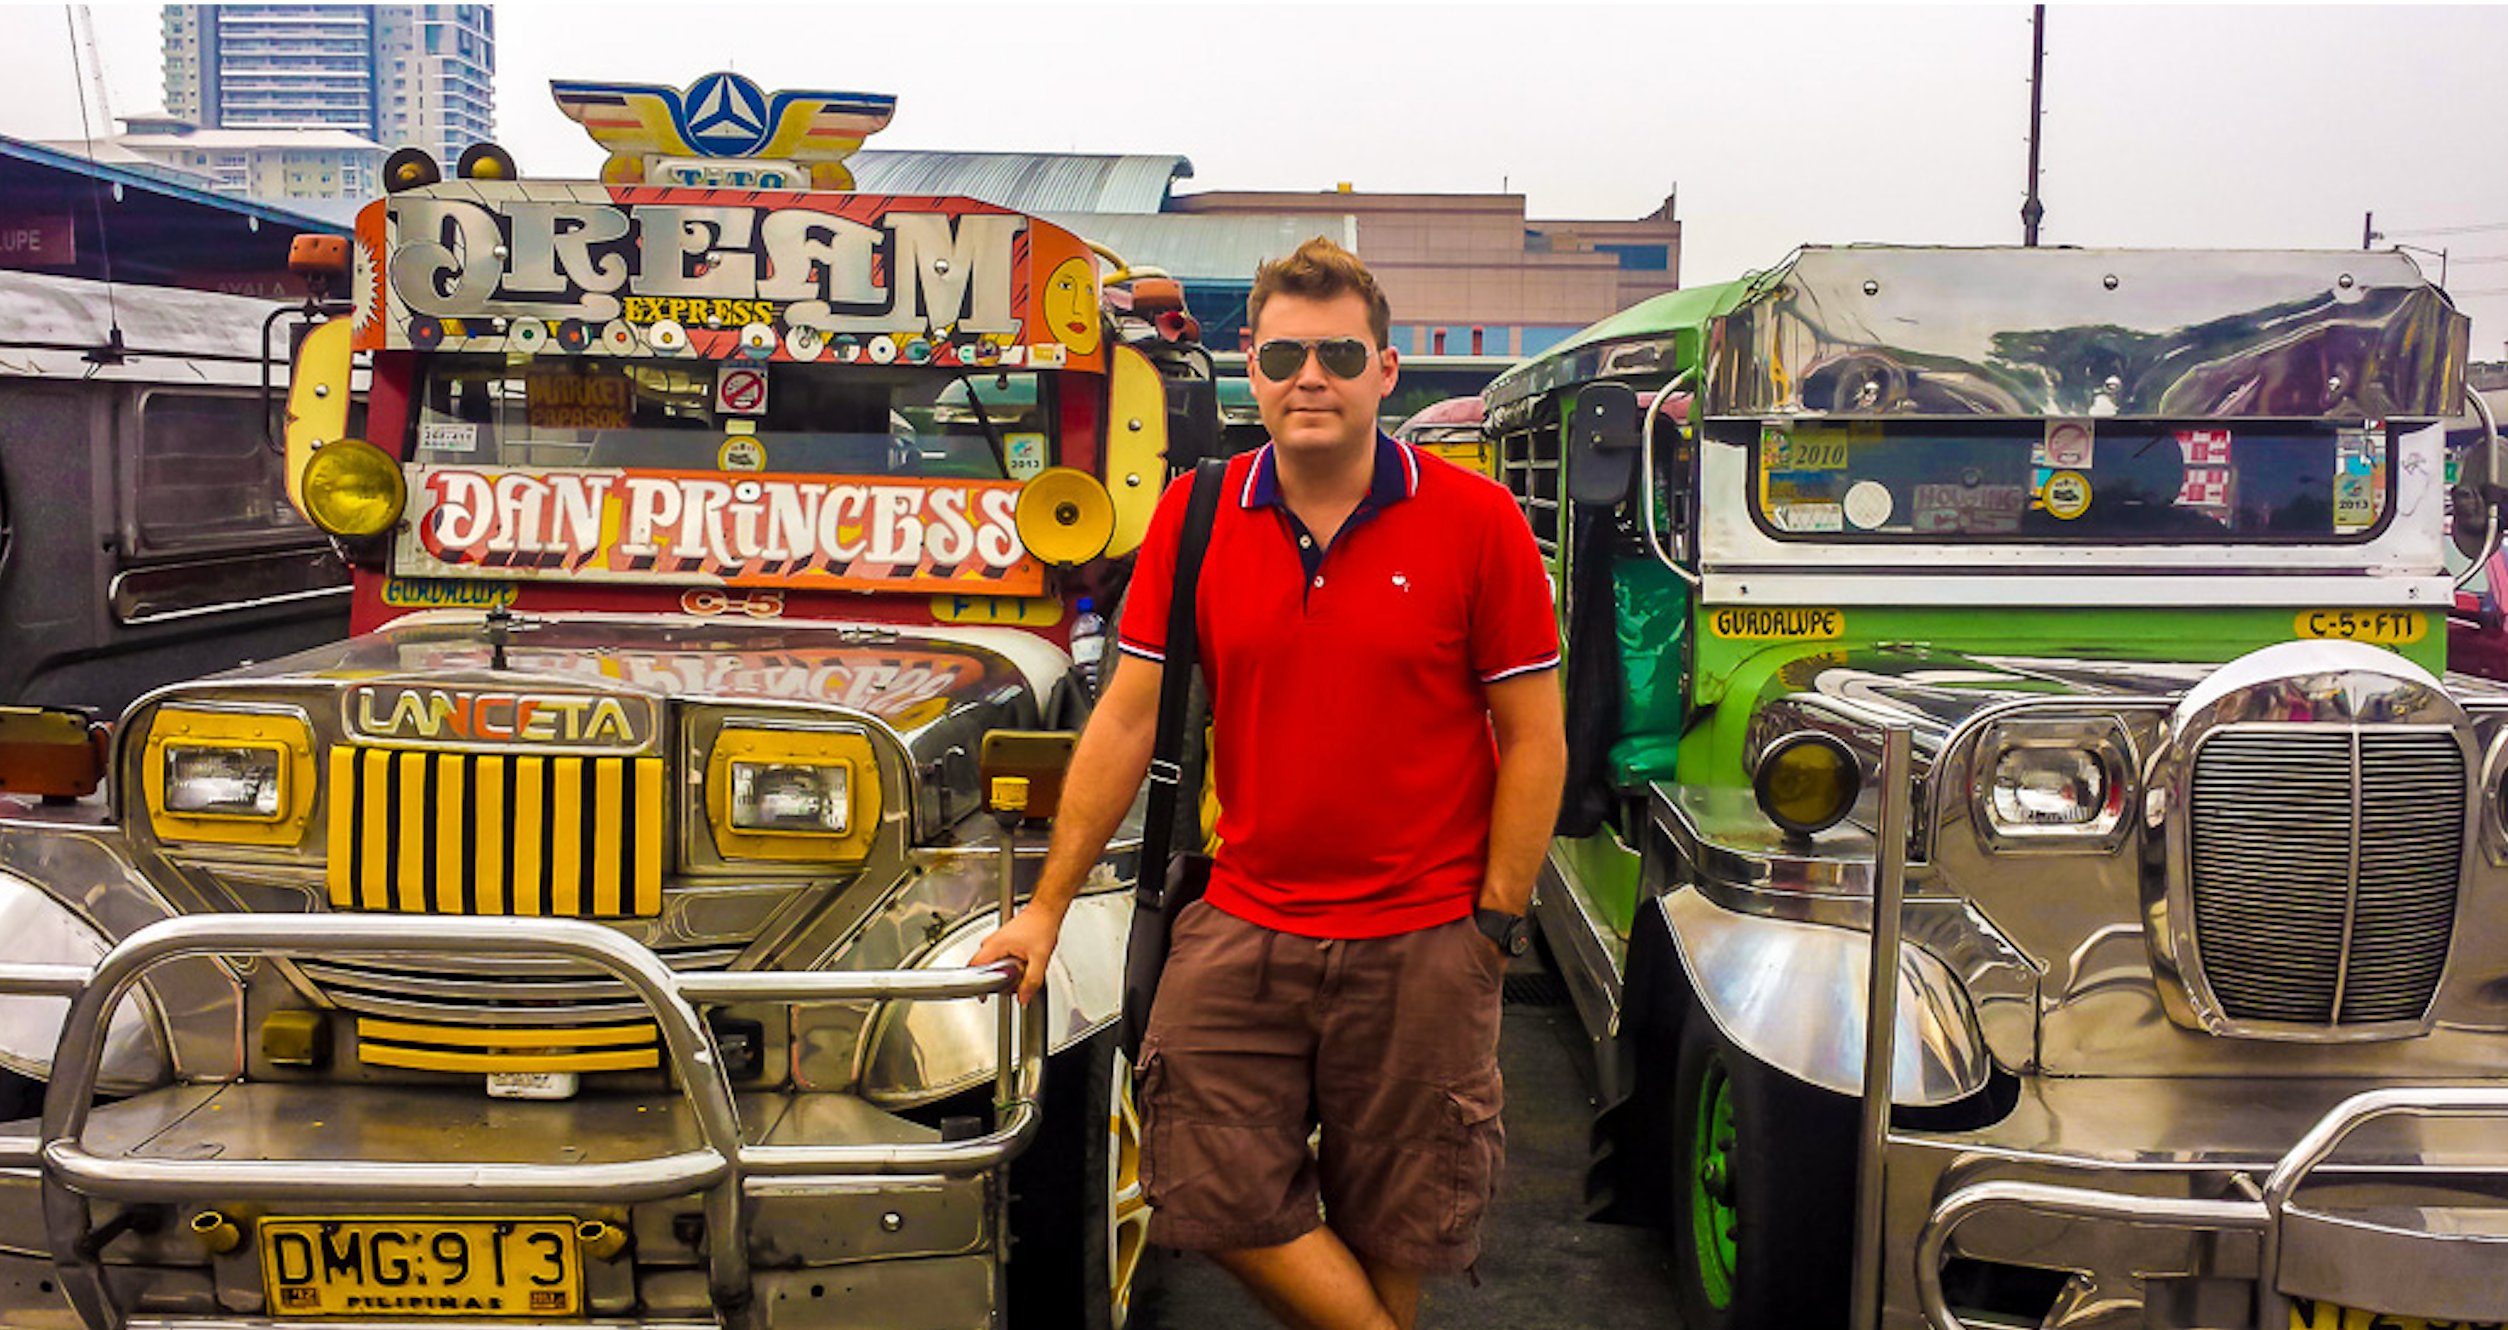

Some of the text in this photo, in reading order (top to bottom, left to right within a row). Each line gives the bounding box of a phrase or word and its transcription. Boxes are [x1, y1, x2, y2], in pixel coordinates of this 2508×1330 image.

[0, 229, 41, 251] UPE
[388, 198, 1028, 334] DREAM
[623, 297, 774, 326] EXPRESS
[1011, 459, 1040, 469] 2013
[1796, 444, 1845, 465] 2010
[433, 471, 613, 552] DAN
[2338, 500, 2369, 510] 2013
[388, 578, 510, 603] GUADALUPE
[681, 588, 785, 619] C-5
[1717, 610, 1836, 636] GUADALUPE
[358, 688, 635, 741] LANCETA
[347, 1296, 503, 1310] PILIPINAS
